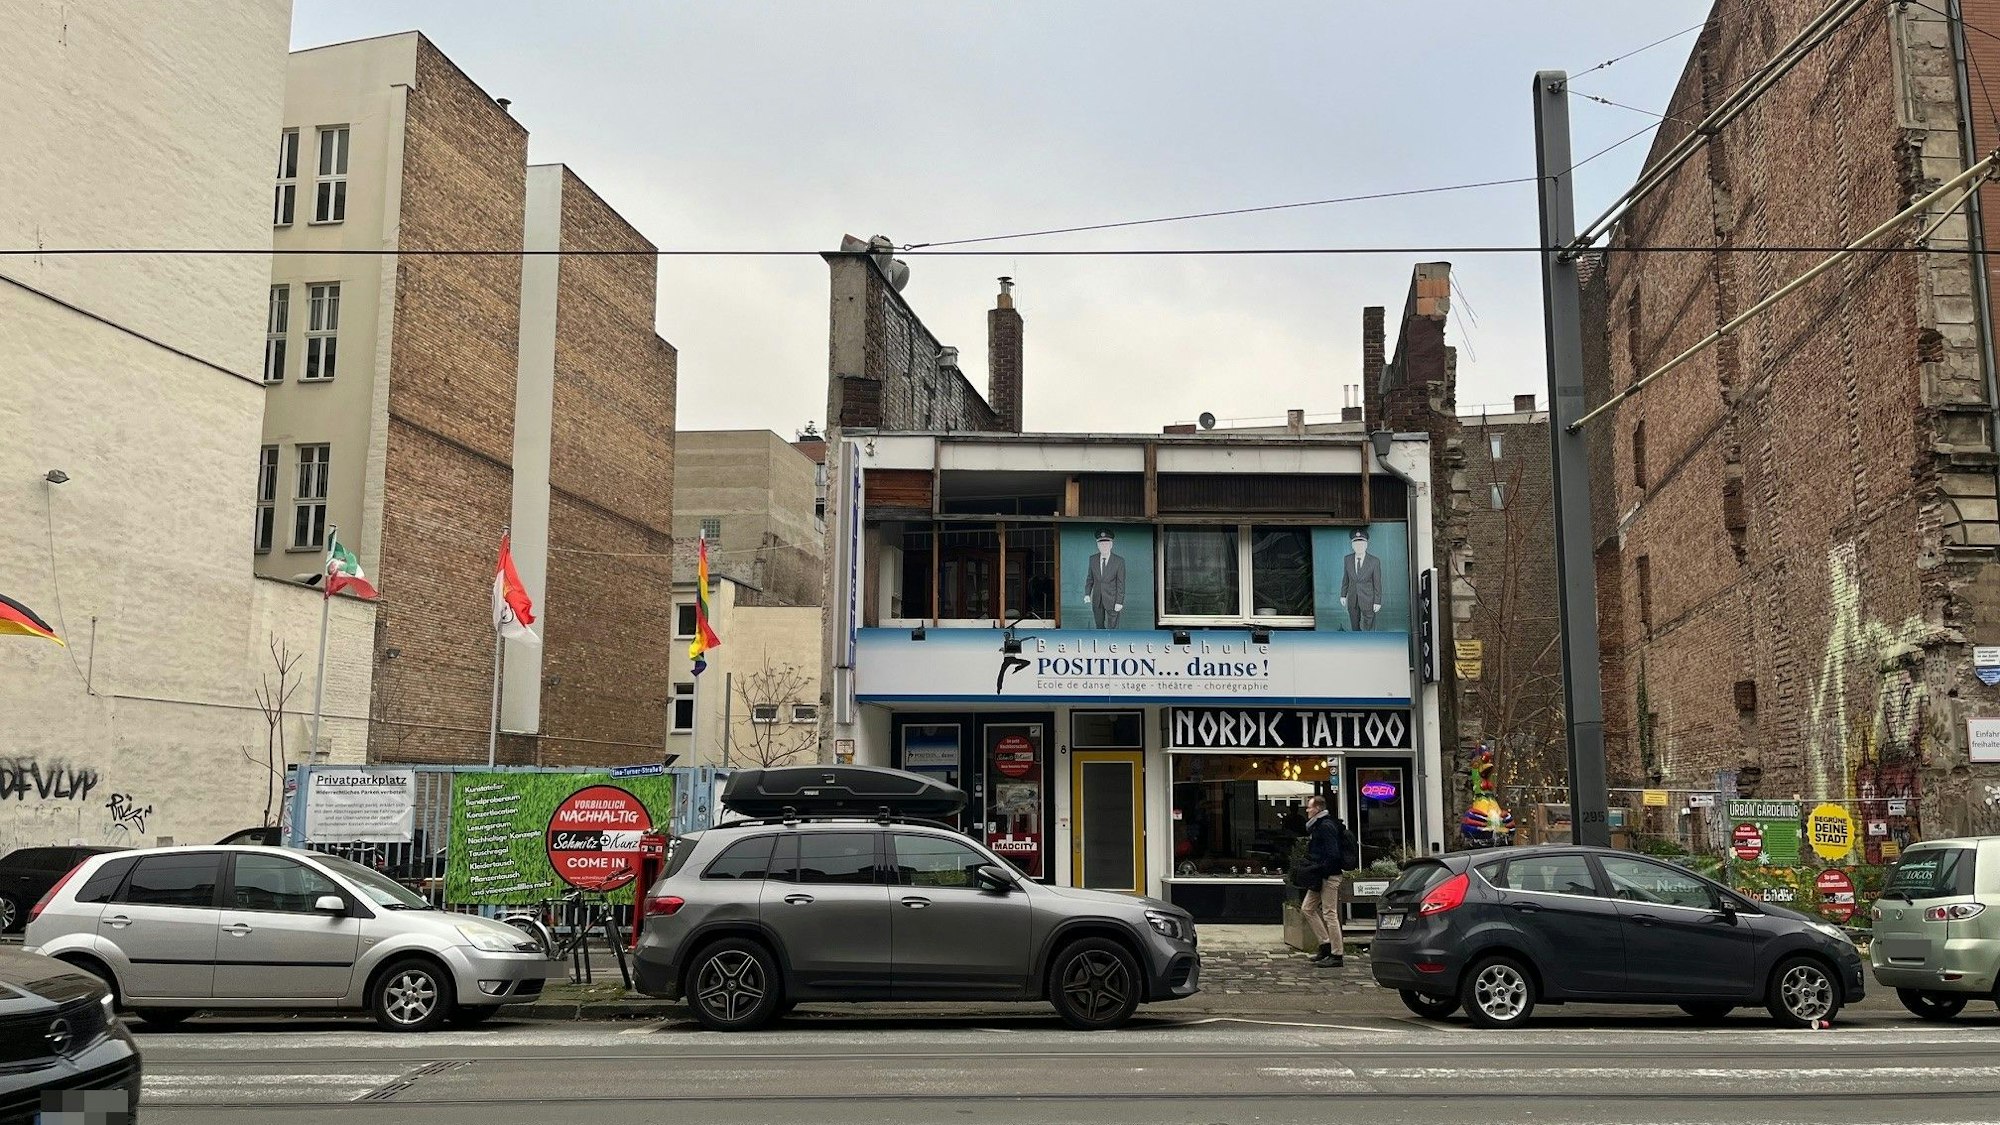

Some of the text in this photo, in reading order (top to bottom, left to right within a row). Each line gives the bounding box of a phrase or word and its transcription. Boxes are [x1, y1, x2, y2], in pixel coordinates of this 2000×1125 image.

[1037, 657, 1179, 676] POSITION...
[1037, 680, 1064, 690] Ecole
[1066, 680, 1079, 690] de
[1082, 680, 1110, 690] danse
[1121, 681, 1147, 692] stage
[1158, 680, 1193, 690] théâtre
[1204, 679, 1269, 692] chorégraphie
[1175, 710, 1405, 748] NORDIC TATTOO
[316, 774, 407, 787] Privatparkplatz
[1361, 785, 1396, 796] OPEN
[465, 794, 521, 806] Bandproberaum
[574, 800, 626, 809] VORBILDLICH
[466, 807, 519, 819] Konzertlocation
[1729, 803, 1799, 817] URBAN GARDENING
[559, 810, 640, 824] NACHHALTIG
[1814, 815, 1847, 823] BEGRÜNE
[466, 821, 512, 832] Lesungsraum
[1815, 823, 1848, 834] DEINE
[552, 832, 599, 849] Schmitz
[1815, 833, 1848, 844] STADT
[468, 846, 509, 857] Tauschregal
[469, 859, 515, 870] Kleidertausch
[567, 857, 625, 868] COME IN
[470, 871, 520, 883] Pflanzentausch
